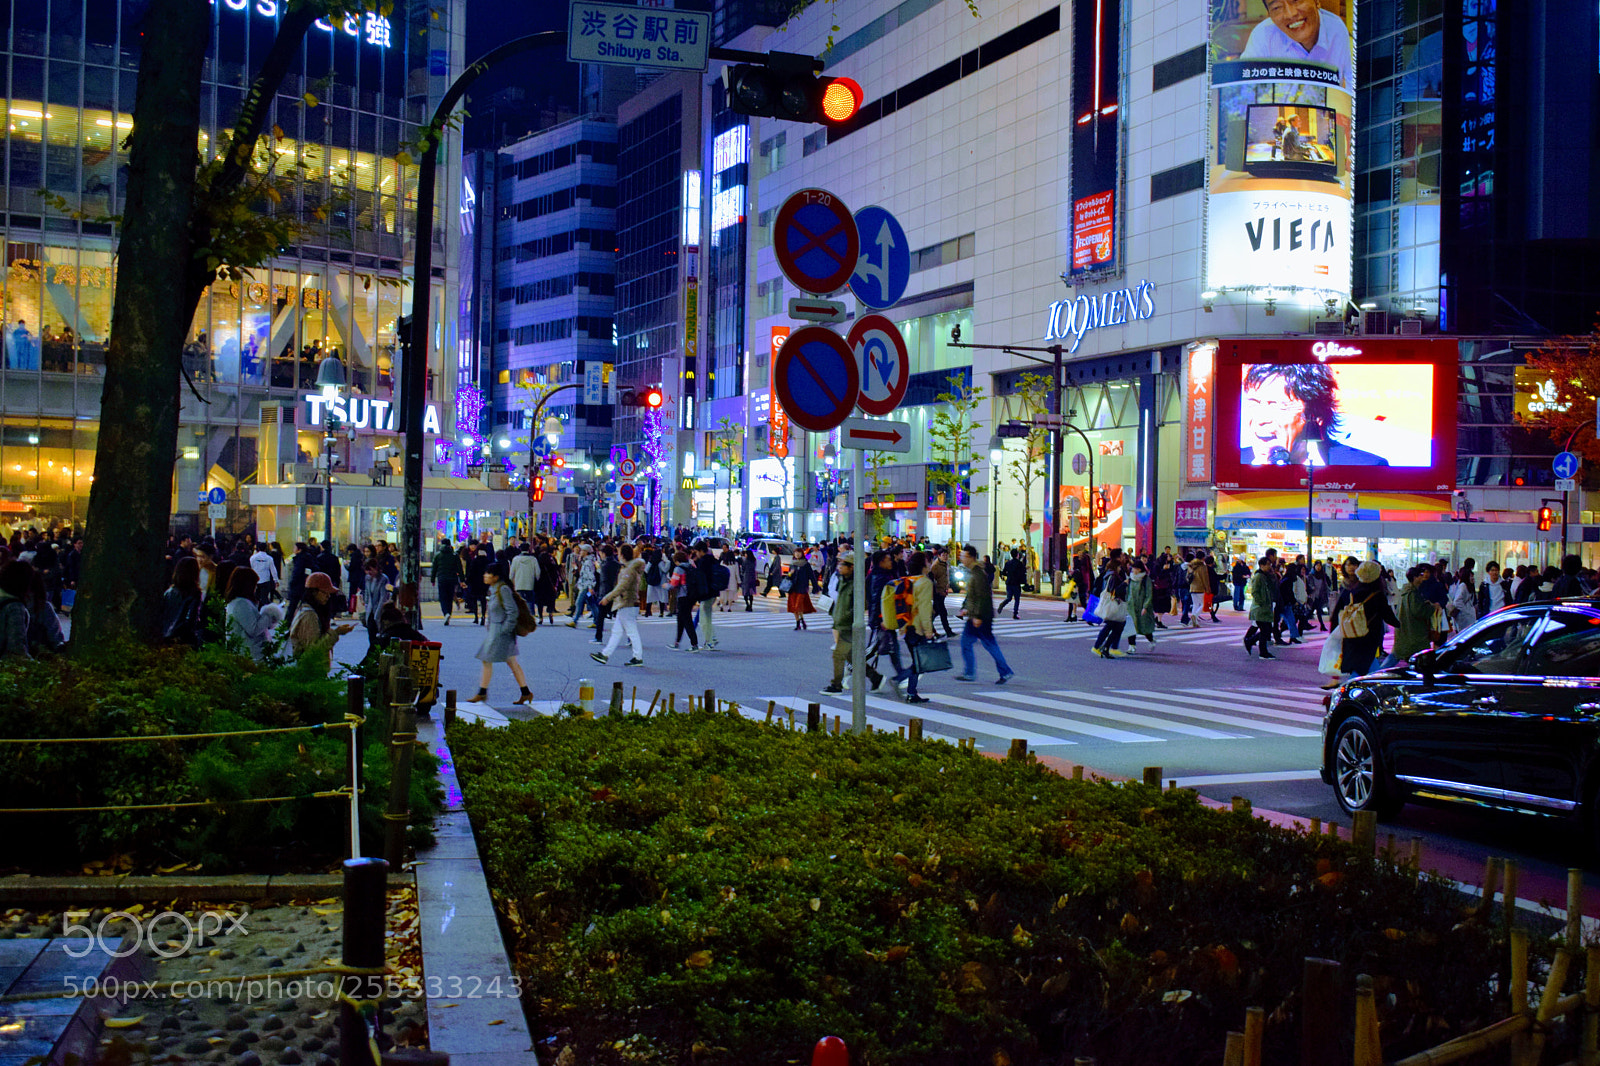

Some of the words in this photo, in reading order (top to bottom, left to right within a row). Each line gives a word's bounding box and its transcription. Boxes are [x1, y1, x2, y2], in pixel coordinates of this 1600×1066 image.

[581, 10, 699, 45] 渋谷駅前
[597, 41, 651, 60] Shibuya
[656, 46, 684, 62] Sta.
[803, 191, 831, 207] 7-20
[1312, 341, 1362, 362] Glico
[420, 652, 430, 684] NORTH
